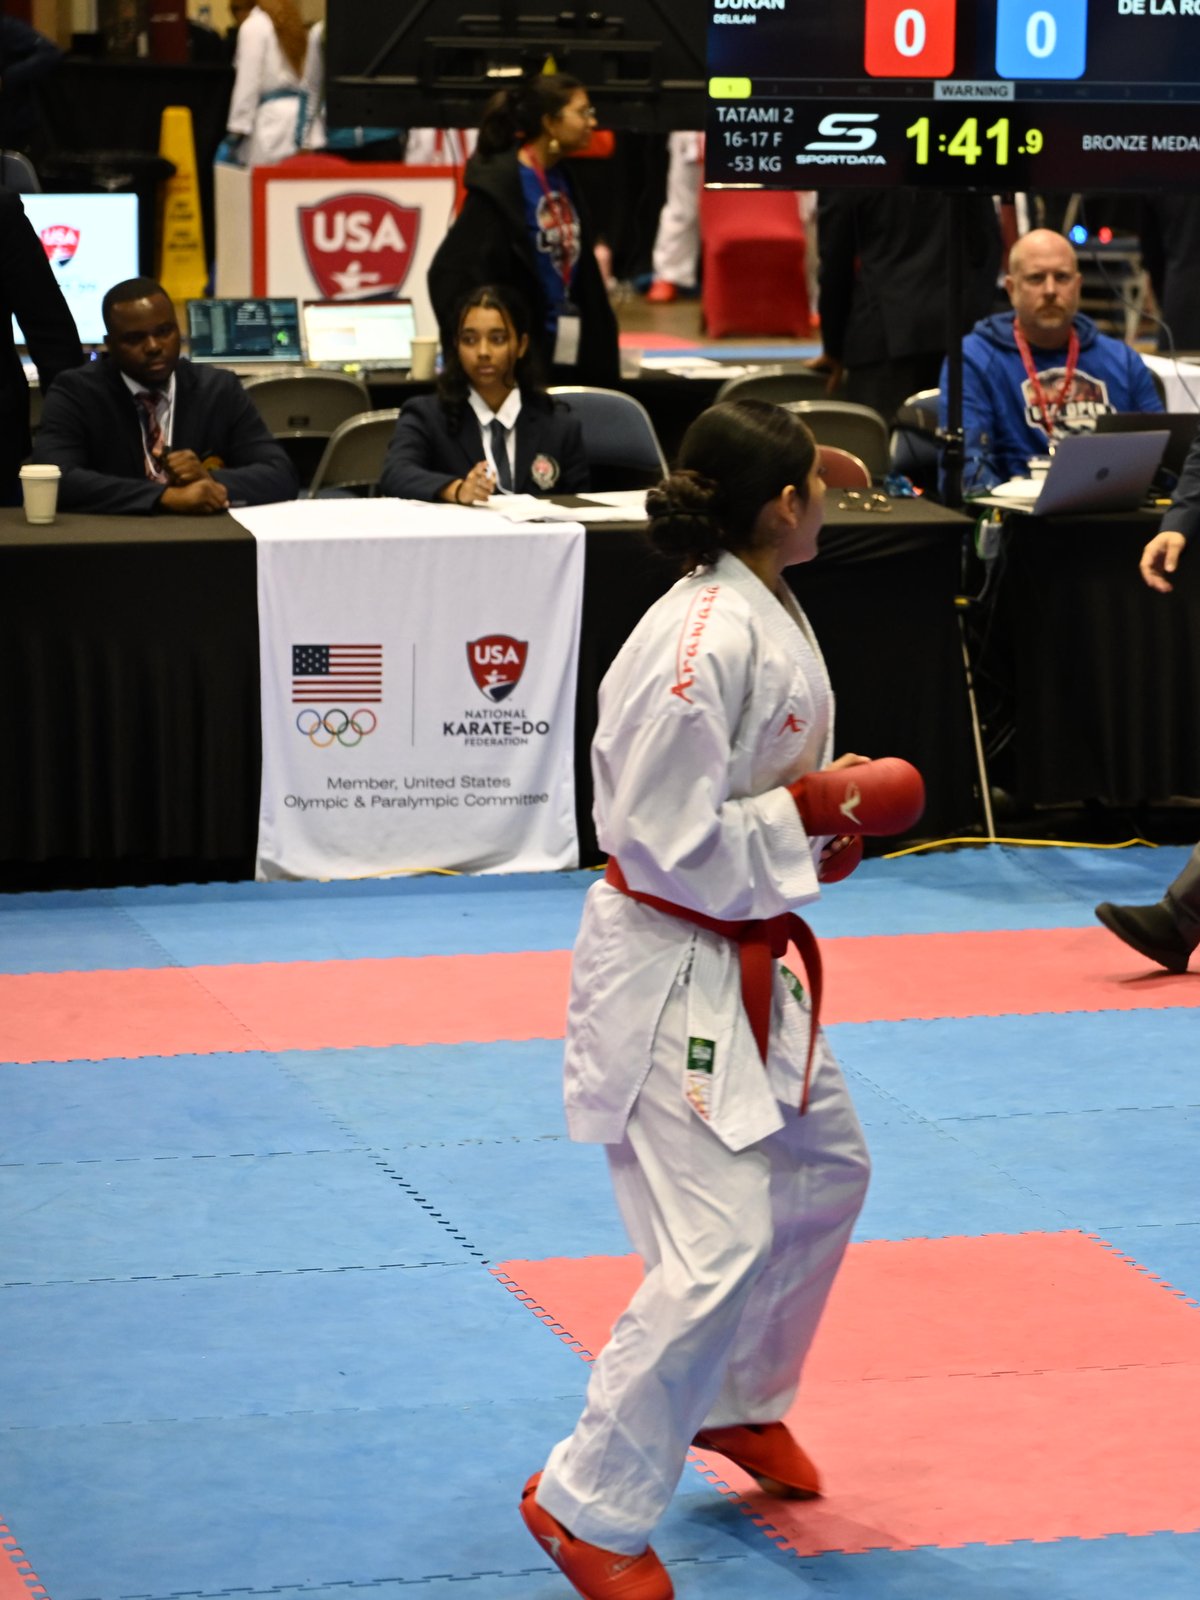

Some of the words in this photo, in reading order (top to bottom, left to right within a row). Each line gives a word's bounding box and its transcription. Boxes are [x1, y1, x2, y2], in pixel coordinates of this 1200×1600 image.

[1118, 0, 1146, 15] DE
[1151, 0, 1177, 15] LA
[713, 13, 756, 24] DELILAH
[894, 9, 926, 57] 0
[1025, 10, 1057, 58] 0
[941, 84, 1009, 97] WARNING
[716, 106, 779, 123] TATAMI
[783, 107, 794, 123] 2
[723, 132, 769, 147] 16-17
[773, 132, 783, 147] F
[1082, 135, 1148, 151] BRONZE
[727, 157, 754, 171] -53
[759, 157, 782, 172] KG
[796, 154, 887, 166] SPORTDATA
[313, 211, 407, 253] USA
[474, 645, 520, 665] USA
[465, 709, 528, 719] NATIONAL
[443, 721, 550, 736] KARATE-DO
[465, 737, 529, 746] FEDERATION
[327, 776, 399, 791] Member,
[404, 776, 457, 789] United
[461, 776, 511, 789] States
[284, 794, 349, 811] Olympic
[354, 795, 366, 808] &
[371, 794, 458, 810] Paralympic
[463, 792, 549, 808] Committee
